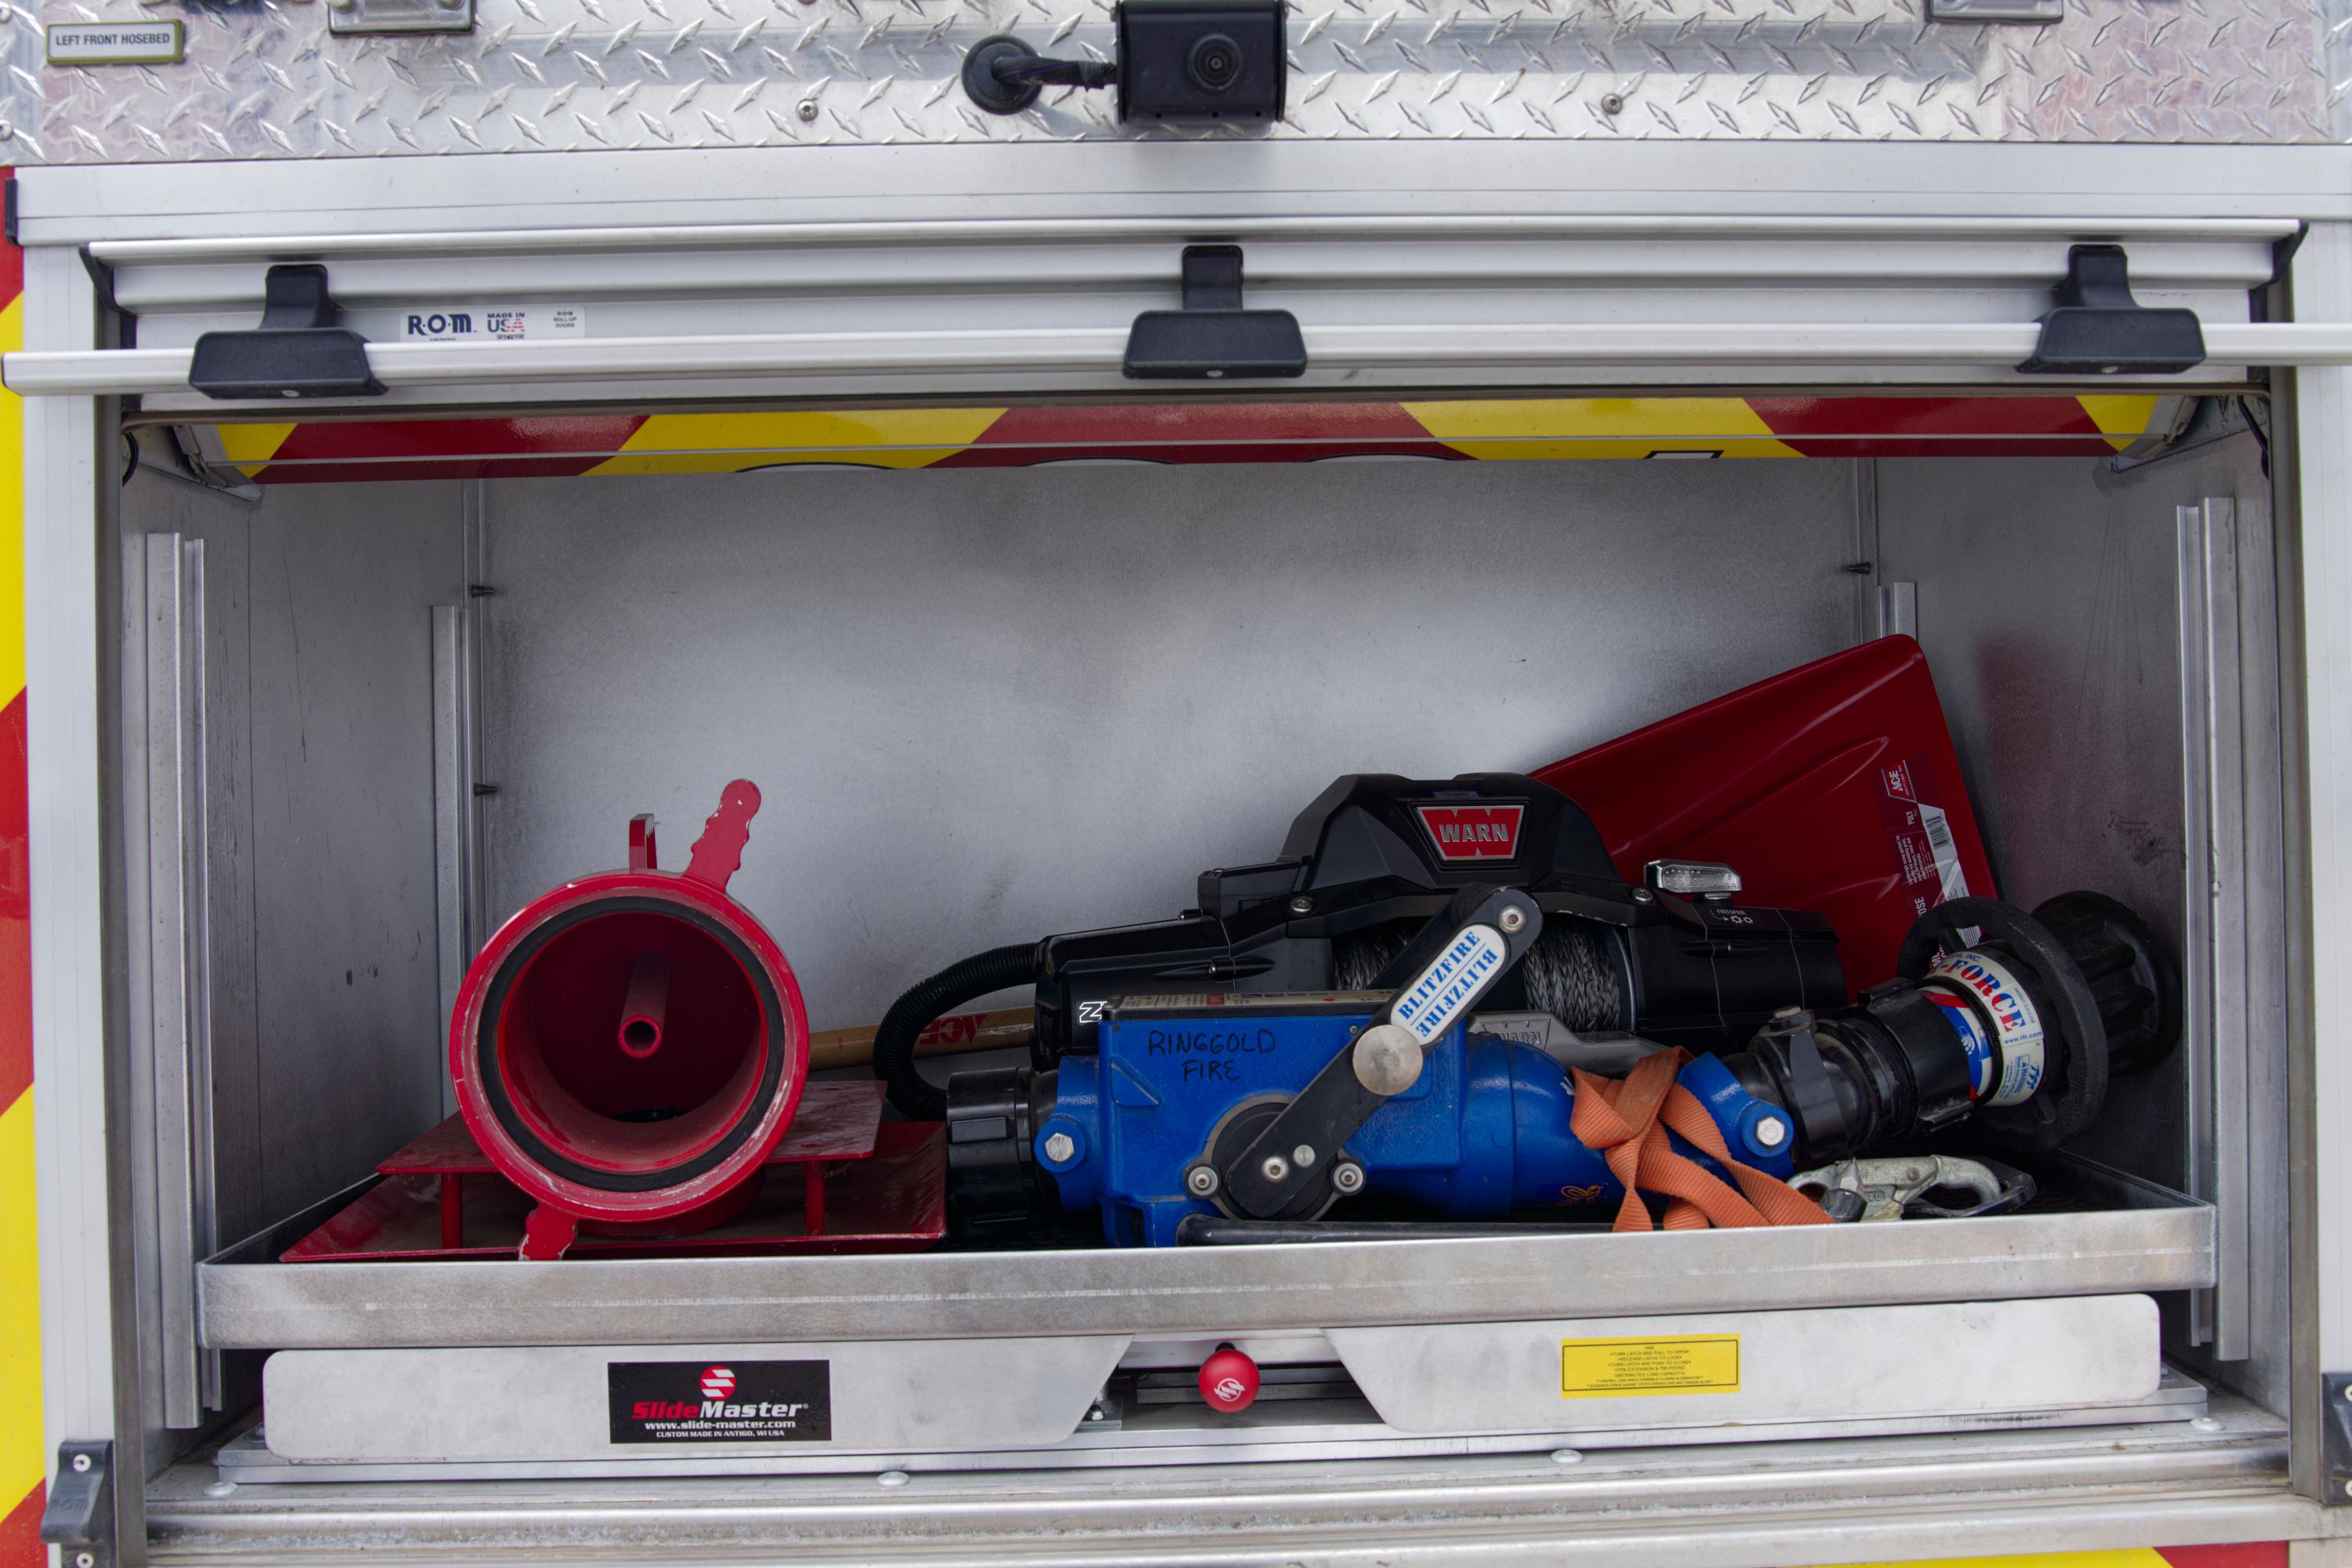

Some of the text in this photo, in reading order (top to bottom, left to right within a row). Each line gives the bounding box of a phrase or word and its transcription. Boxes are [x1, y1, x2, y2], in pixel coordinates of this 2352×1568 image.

[56, 33, 170, 45] LEFT FRONT HOSEBED
[487, 318, 525, 332] USA
[1889, 770, 1904, 792] ACE
[1439, 823, 1509, 843] WARN
[1398, 931, 1481, 1020] BLITZFIRE
[1416, 948, 1498, 1037] BLITZFIRE
[1148, 1028, 1277, 1056] RINGGOLD
[1181, 1060, 1240, 1083] FIRE
[645, 1420, 796, 1430] www.slide-master.com
